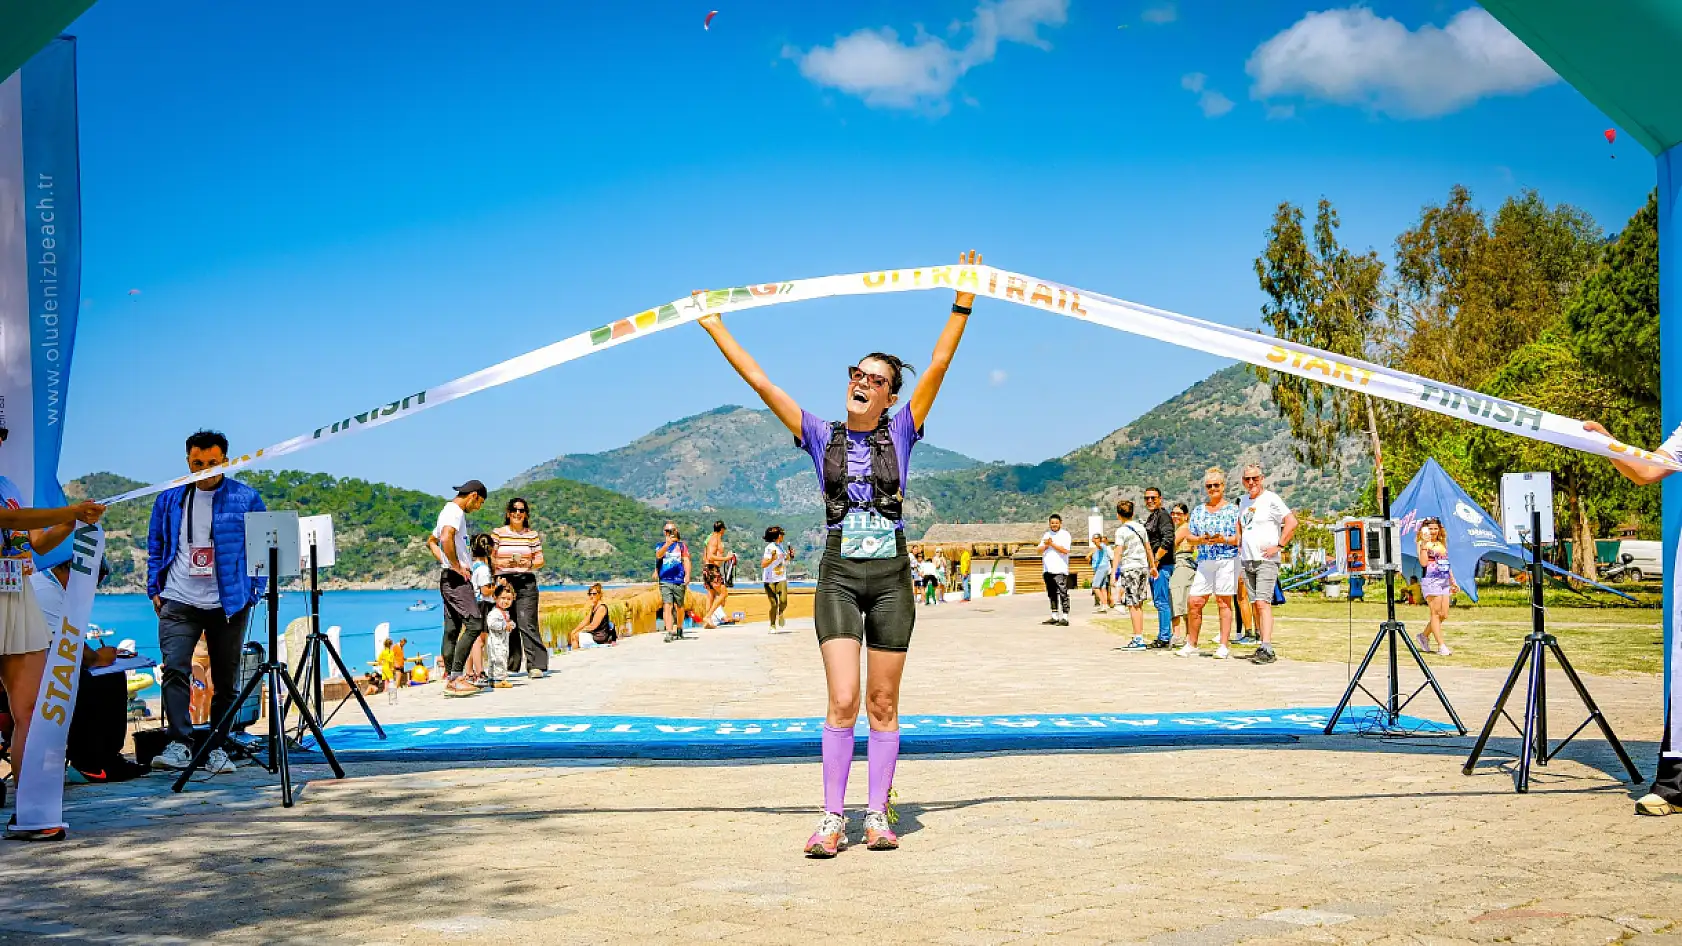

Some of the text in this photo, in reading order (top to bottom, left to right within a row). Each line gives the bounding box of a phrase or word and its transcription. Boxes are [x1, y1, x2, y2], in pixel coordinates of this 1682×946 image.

[35, 172, 60, 428] www.oludenizbeach.tr
[1265, 344, 1377, 388] START
[1418, 383, 1545, 432] FINISH
[40, 615, 81, 727] START
[403, 723, 640, 736] TRAIL
